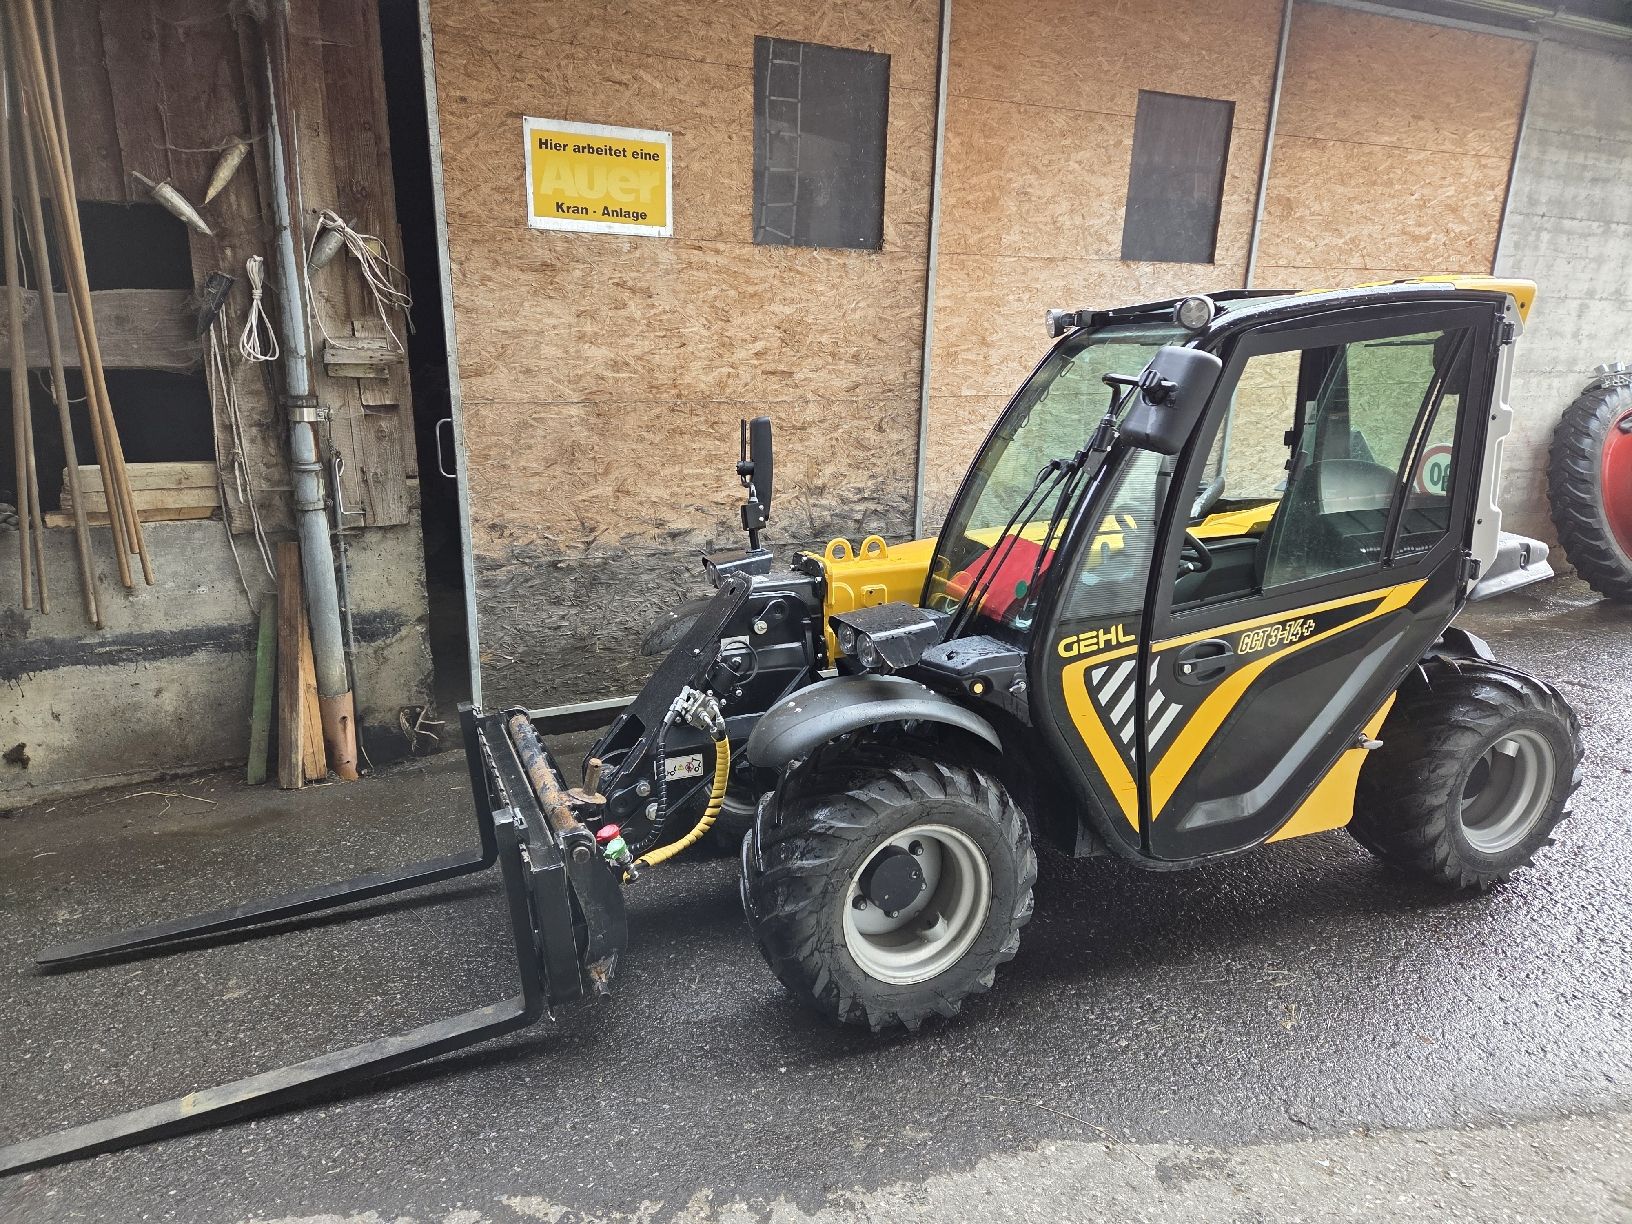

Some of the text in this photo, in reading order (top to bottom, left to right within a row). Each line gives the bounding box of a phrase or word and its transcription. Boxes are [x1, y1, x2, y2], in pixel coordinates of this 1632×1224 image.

[538, 137, 660, 162] Hier arbeitet eine
[555, 201, 589, 216] Kran
[601, 205, 648, 222] Anlage
[1058, 623, 1136, 658] GEHL
